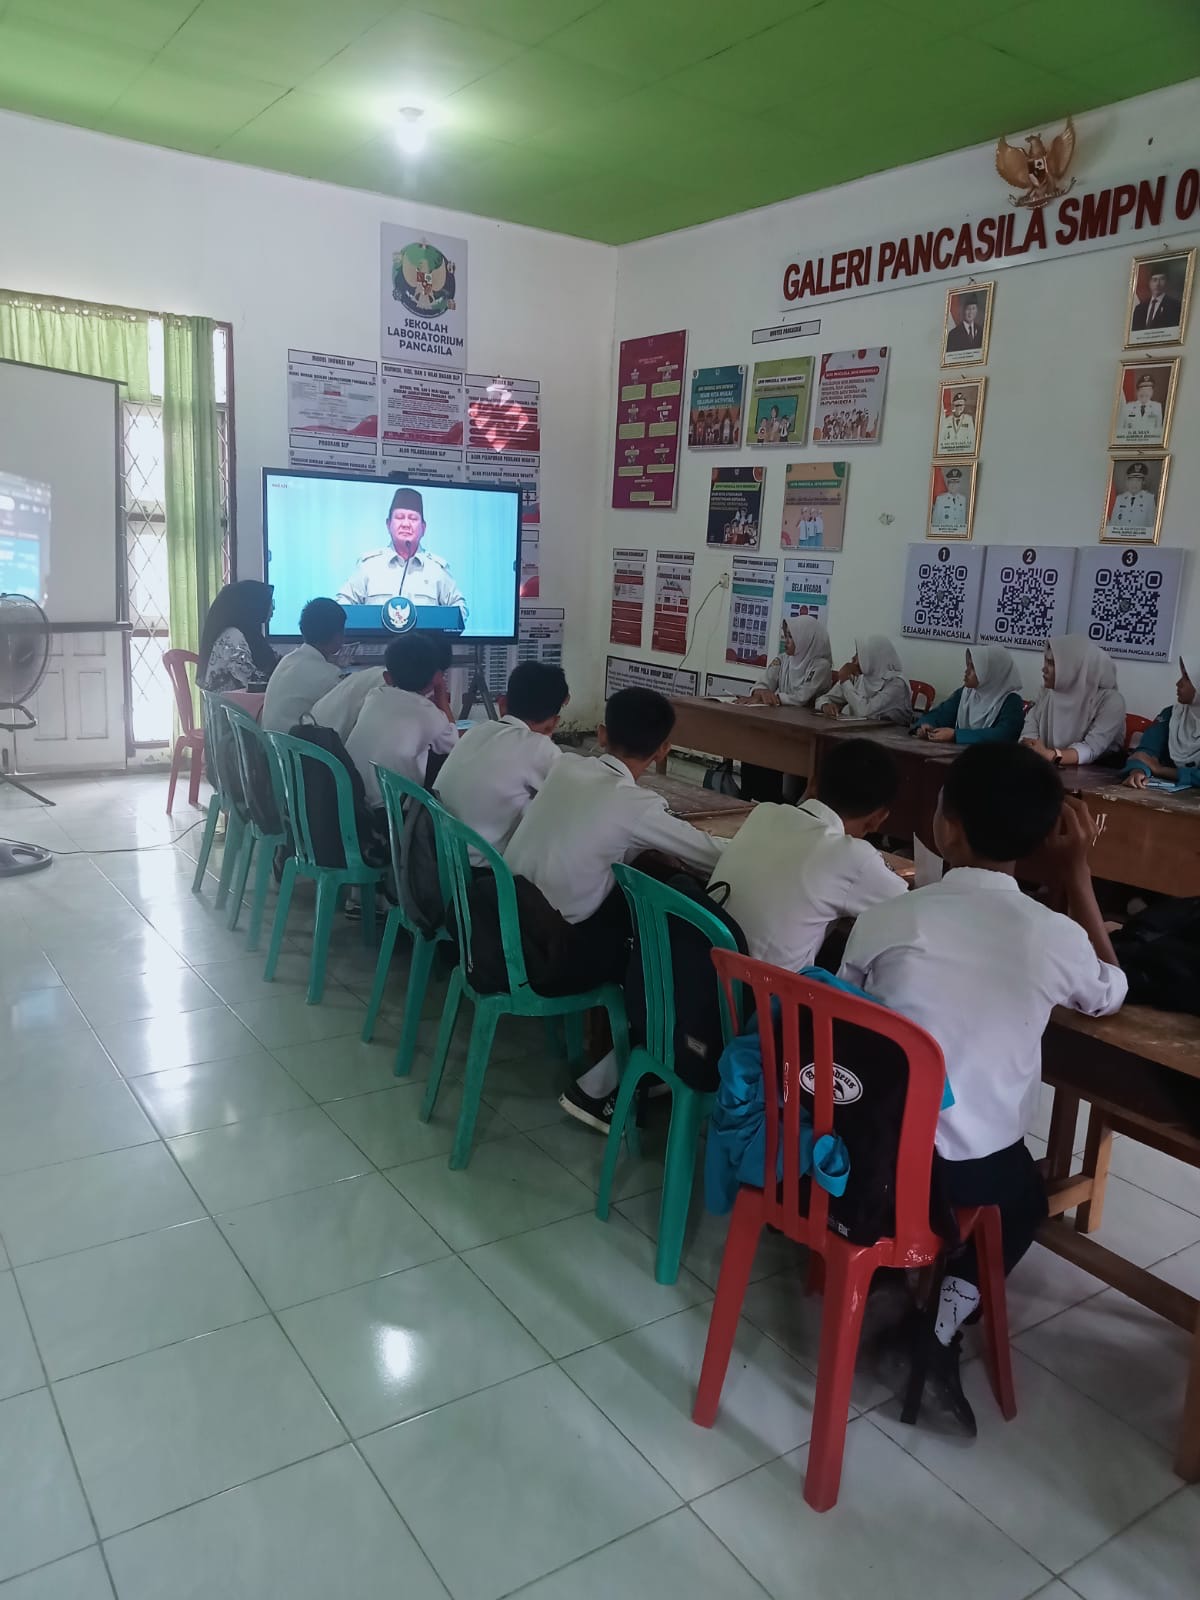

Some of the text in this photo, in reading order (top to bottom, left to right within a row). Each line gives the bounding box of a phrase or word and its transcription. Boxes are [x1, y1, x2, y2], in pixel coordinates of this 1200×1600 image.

[783, 169, 1200, 301] GALERI PANCASILA SMPN 0
[405, 318, 448, 334] SEKOLAH
[388, 326, 464, 347] LABORATORIUM
[400, 339, 453, 356] PANCASILA
[941, 550, 947, 559] 1
[1026, 551, 1034, 562] 2
[1125, 552, 1135, 563] 3
[792, 582, 822, 593] BELA NEGARA
[903, 625, 971, 639] SEJARAH PANCASILA
[980, 634, 1046, 647] WAWASAN KEBANGS
[1128, 648, 1154, 656] PANCASILA
